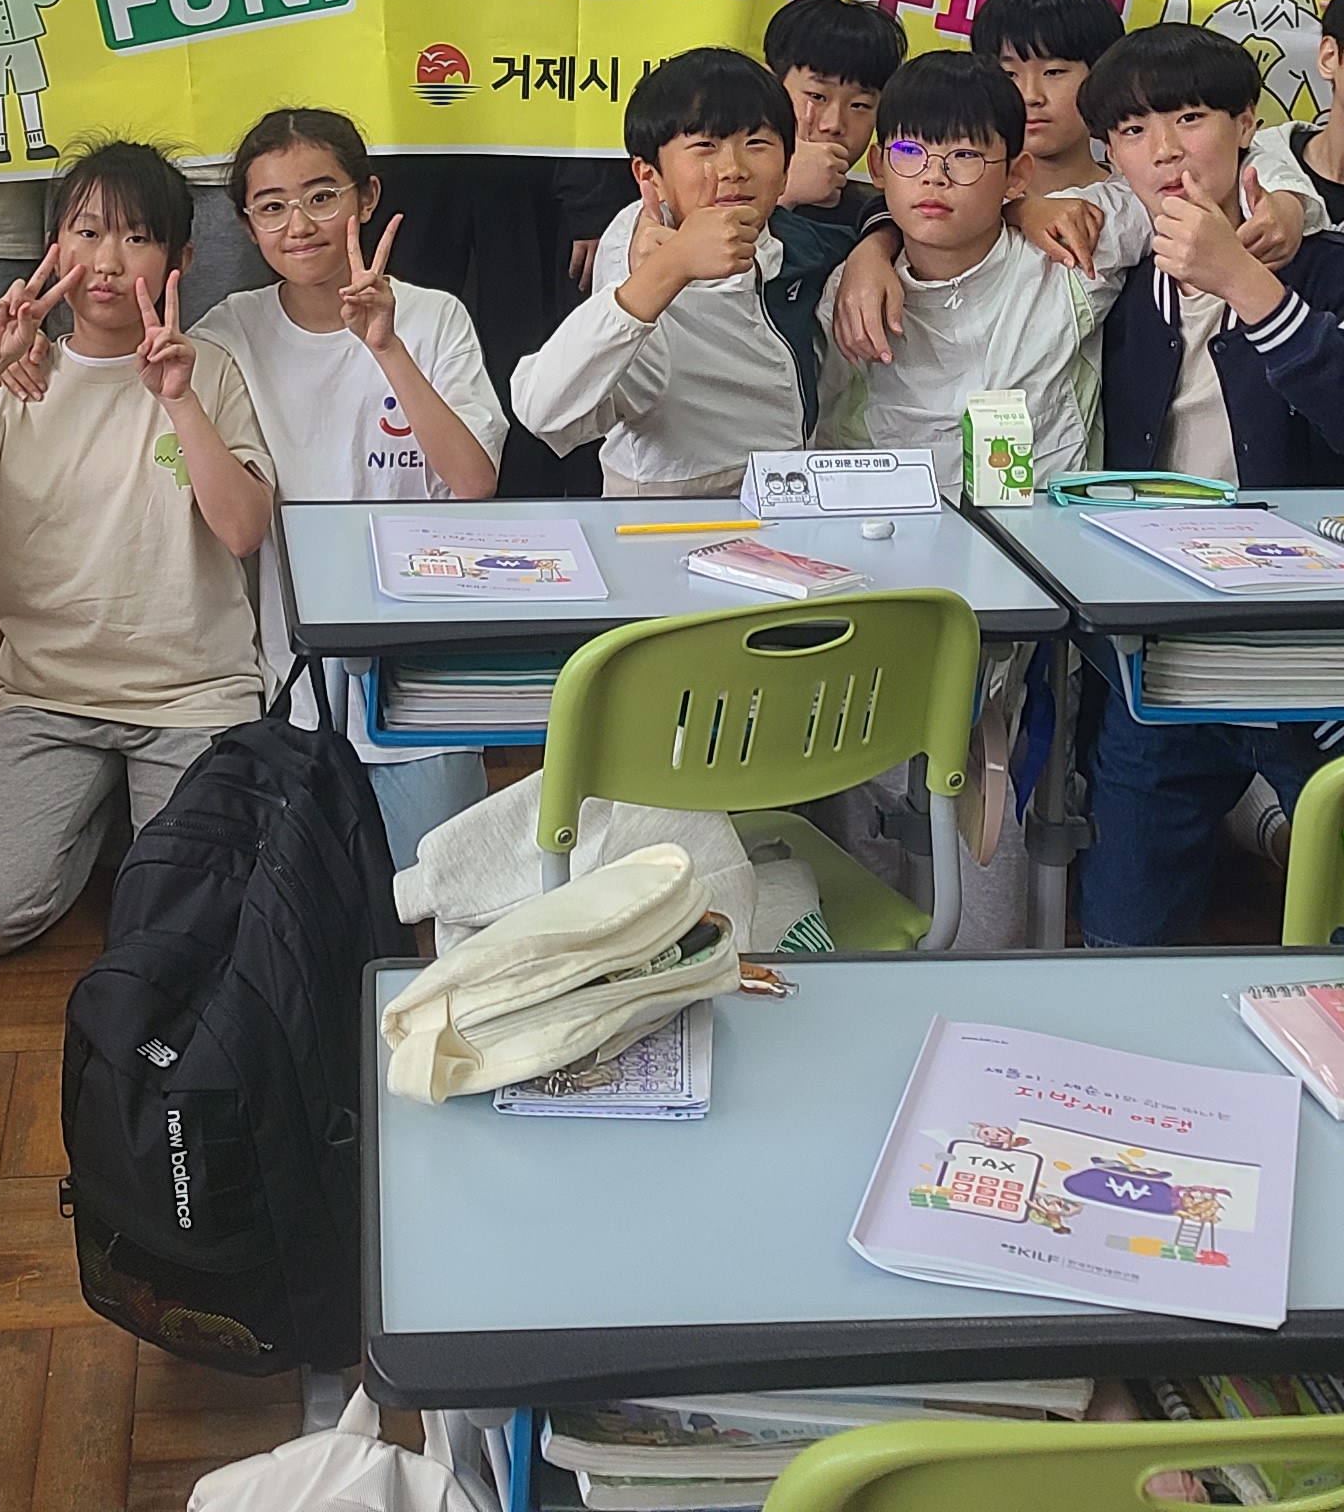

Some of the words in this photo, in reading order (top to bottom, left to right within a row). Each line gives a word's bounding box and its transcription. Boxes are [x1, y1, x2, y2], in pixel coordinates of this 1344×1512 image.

[491, 54, 620, 103] 거제시
[367, 449, 424, 469] NICE.
[167, 1109, 184, 1148] new
[1014, 1085, 1113, 1117] 지방세
[1129, 1114, 1193, 1135] 여행
[968, 1155, 1017, 1174] TAX
[171, 1150, 193, 1230] balance
[1017, 1245, 1060, 1264] KILF
